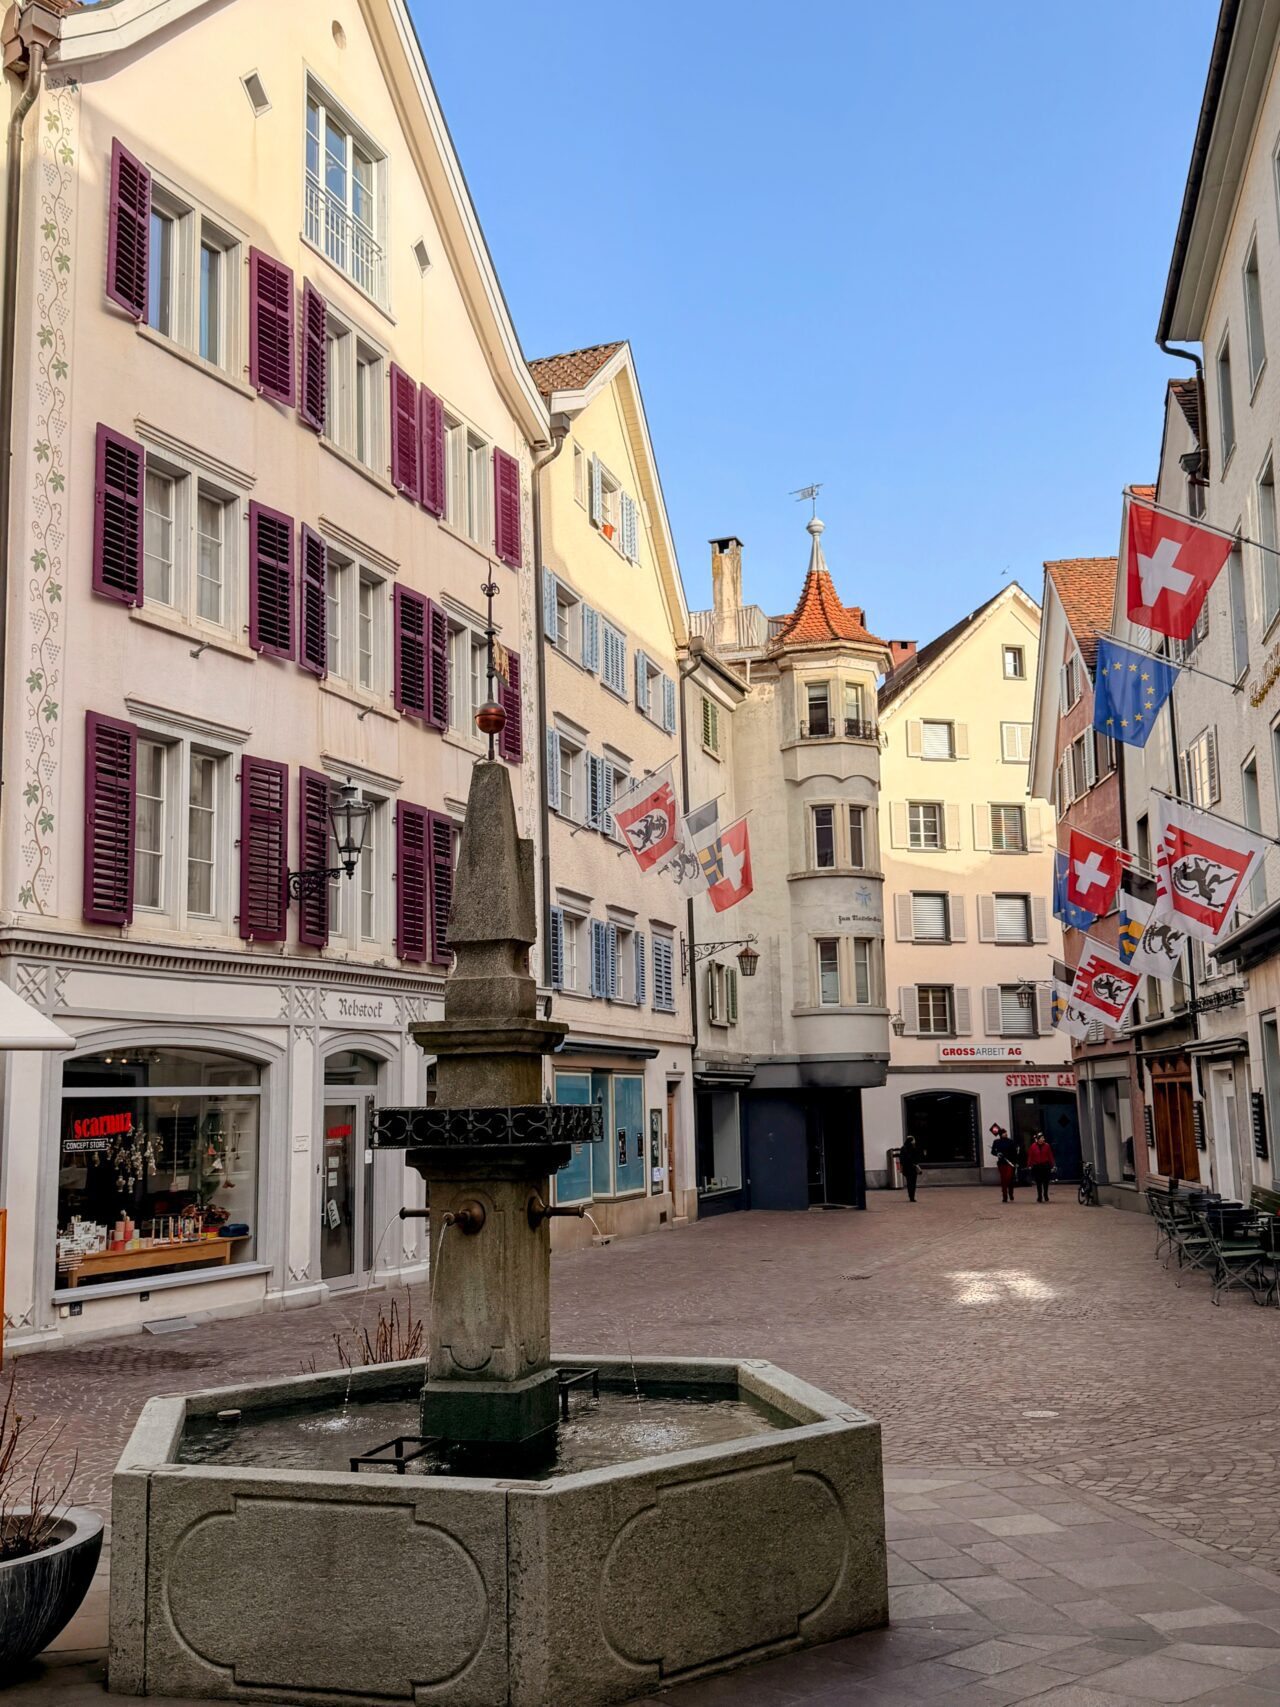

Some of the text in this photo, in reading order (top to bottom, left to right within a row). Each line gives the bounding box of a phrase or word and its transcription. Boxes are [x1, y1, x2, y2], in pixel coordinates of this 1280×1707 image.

[338, 998, 383, 1018] Rebstock
[942, 1047, 1022, 1056] GROSSARBEIT AG
[1005, 1074, 1049, 1087] STREET
[66, 1141, 106, 1150] CONCEPT STORE
